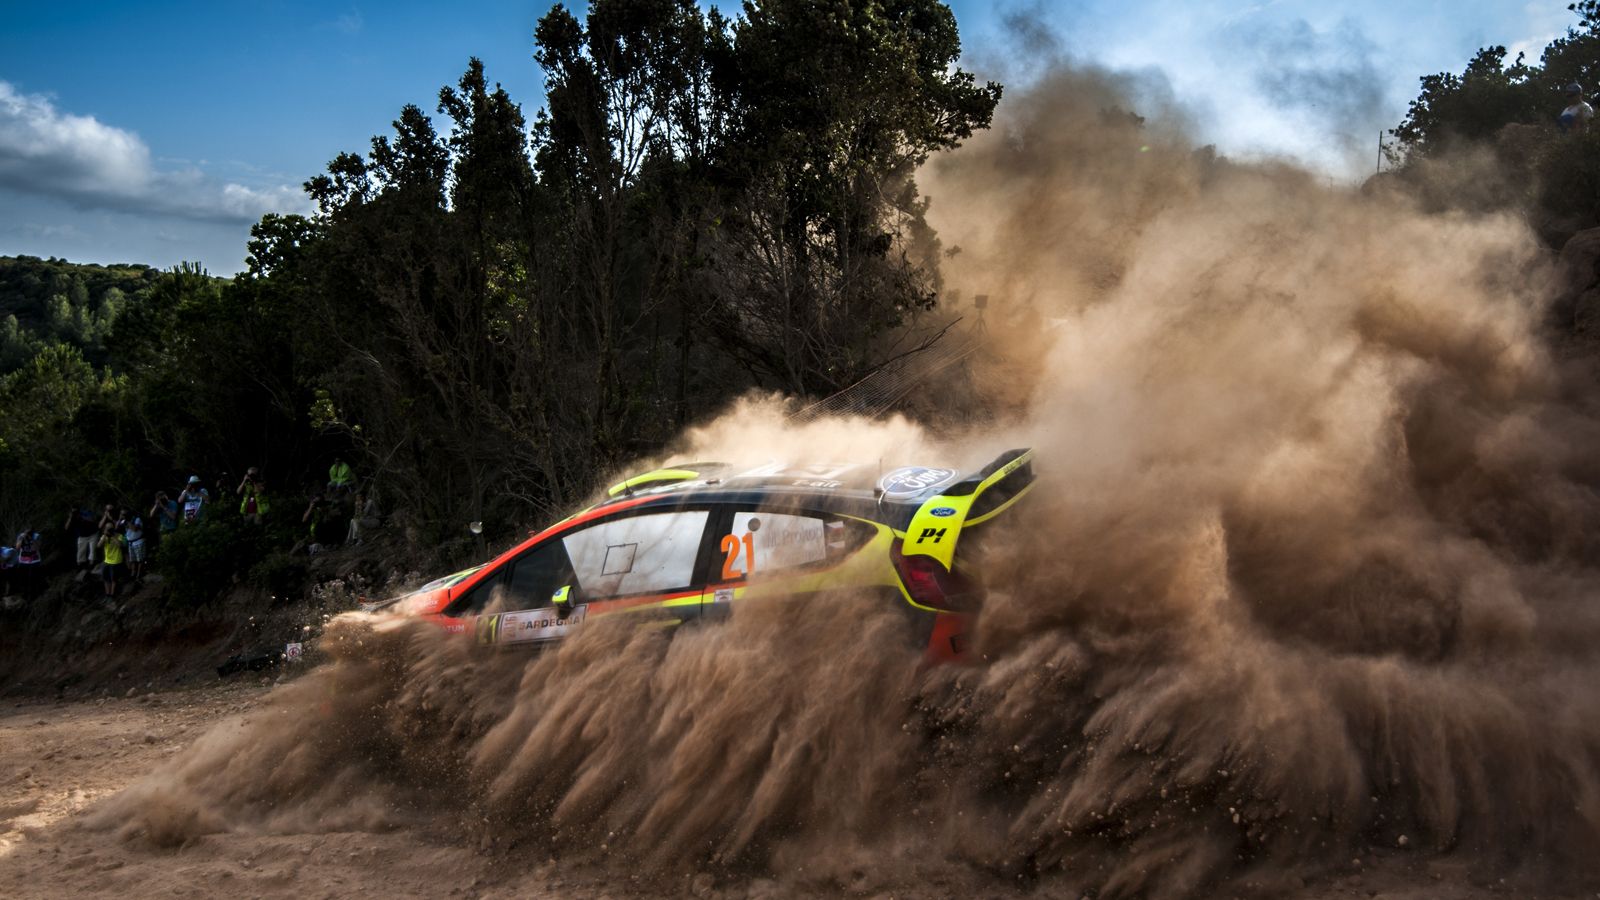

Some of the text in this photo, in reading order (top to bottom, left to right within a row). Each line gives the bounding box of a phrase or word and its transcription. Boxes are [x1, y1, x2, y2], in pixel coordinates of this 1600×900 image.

[888, 467, 950, 489] Ford
[932, 507, 954, 516] Ford
[916, 527, 948, 544] P1
[720, 531, 755, 581] 21
[519, 615, 580, 631] SARDEGNA
